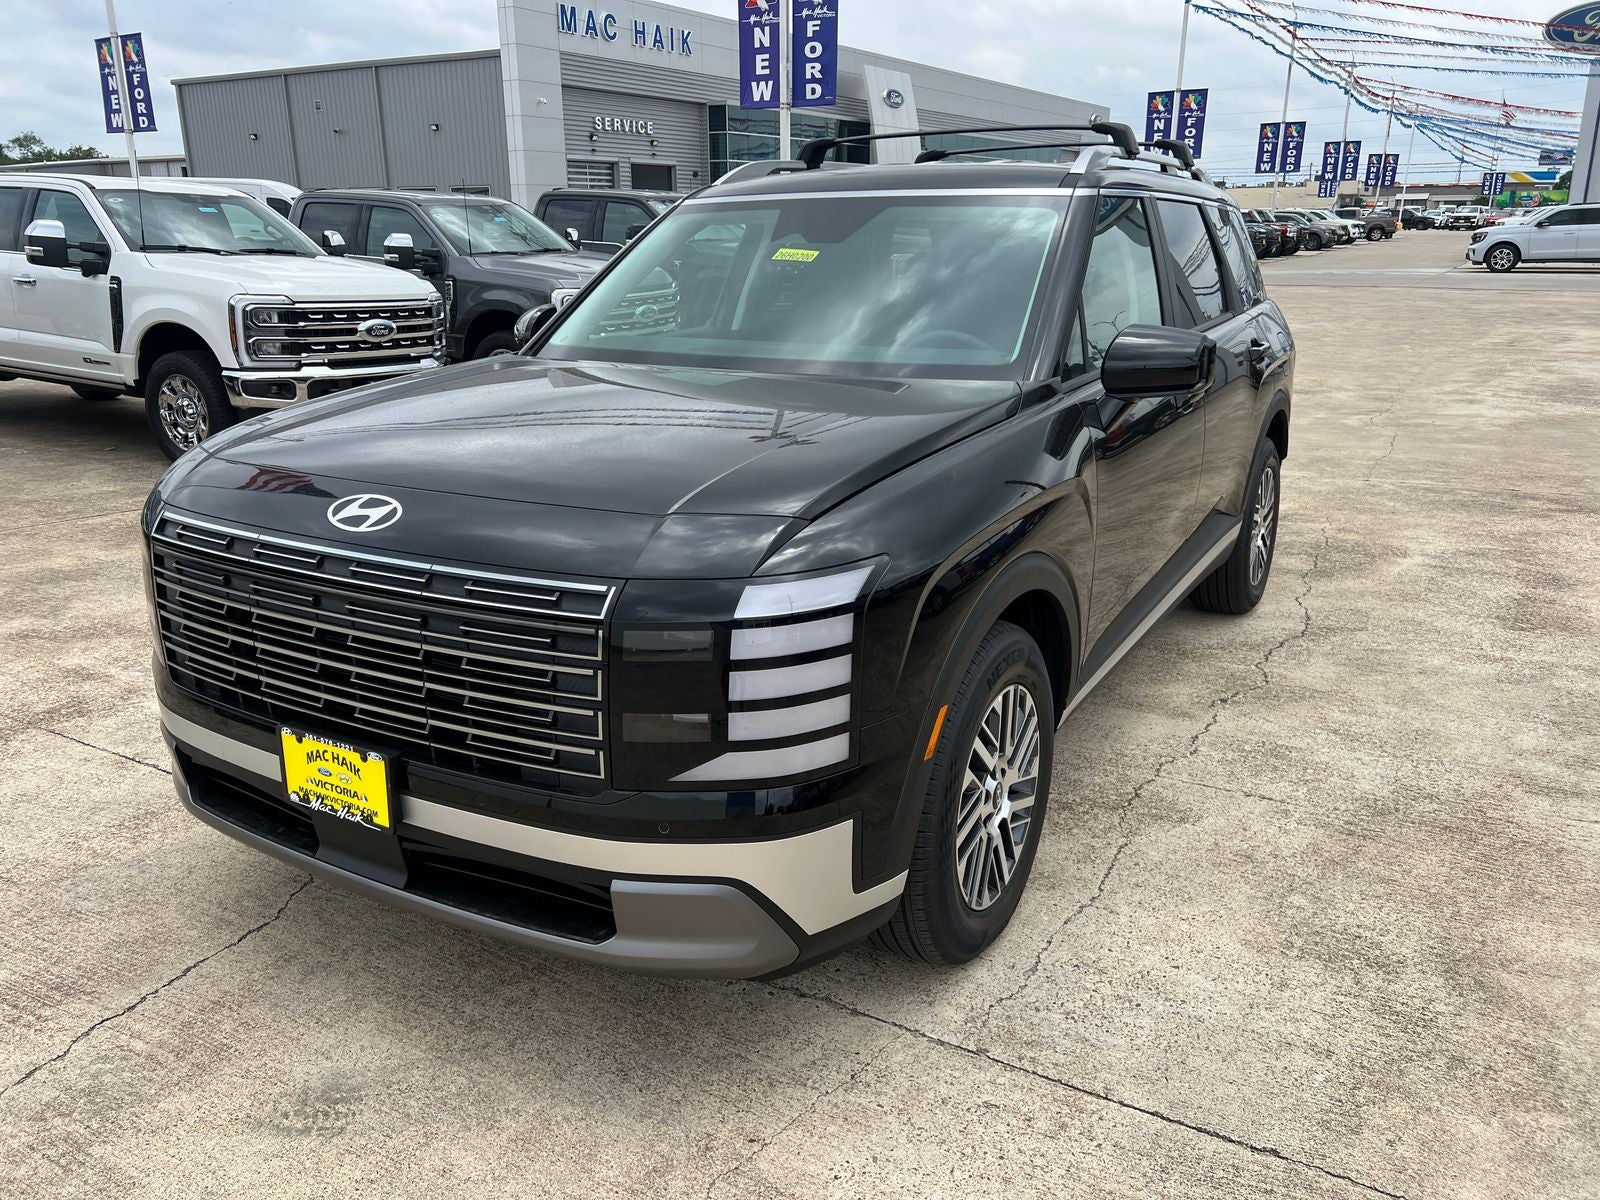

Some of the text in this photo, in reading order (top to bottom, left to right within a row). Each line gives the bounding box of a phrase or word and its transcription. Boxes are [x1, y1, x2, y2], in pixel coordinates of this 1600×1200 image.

[559, 3, 693, 55] MAC HAIK
[751, 26, 773, 102] NEW
[804, 20, 823, 100] FORD
[107, 75, 123, 128] NEW
[132, 73, 149, 128] FORD
[595, 116, 654, 134] SERVICE
[1260, 142, 1273, 171] NEW
[1285, 141, 1297, 171] FORD
[1324, 157, 1334, 180] NEW
[1344, 156, 1354, 180] FORD
[1367, 166, 1377, 186] NEW
[1384, 166, 1393, 186] FORD
[371, 325, 389, 336] Ford
[306, 749, 362, 780] MAC HAIK
[313, 777, 360, 801] VICTORIA
[309, 797, 333, 813] Mac
